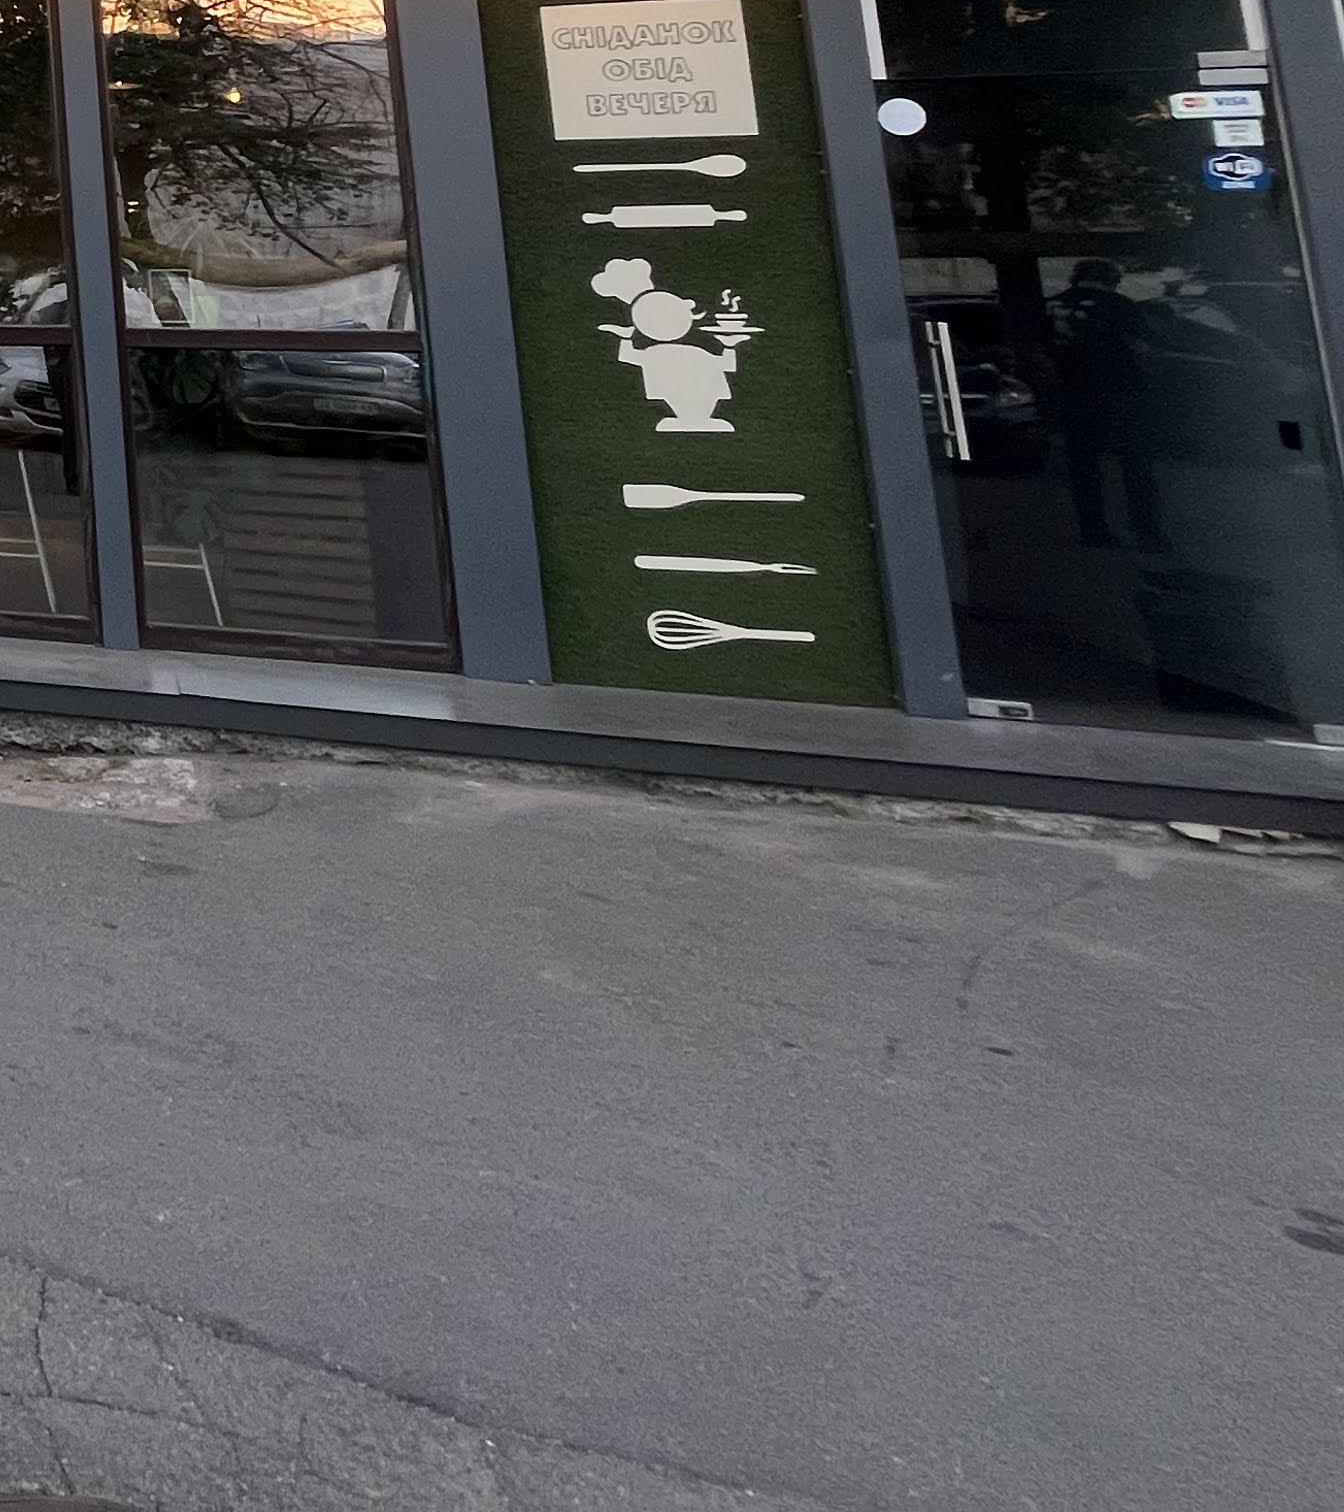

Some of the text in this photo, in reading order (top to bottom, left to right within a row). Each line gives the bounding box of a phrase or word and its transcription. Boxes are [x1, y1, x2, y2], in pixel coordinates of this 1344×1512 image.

[552, 19, 736, 51] СНІДАНОК
[602, 56, 694, 83] ОБІД
[585, 90, 718, 117] ВЕЧЕРЯ
[1214, 96, 1249, 106] VISA
